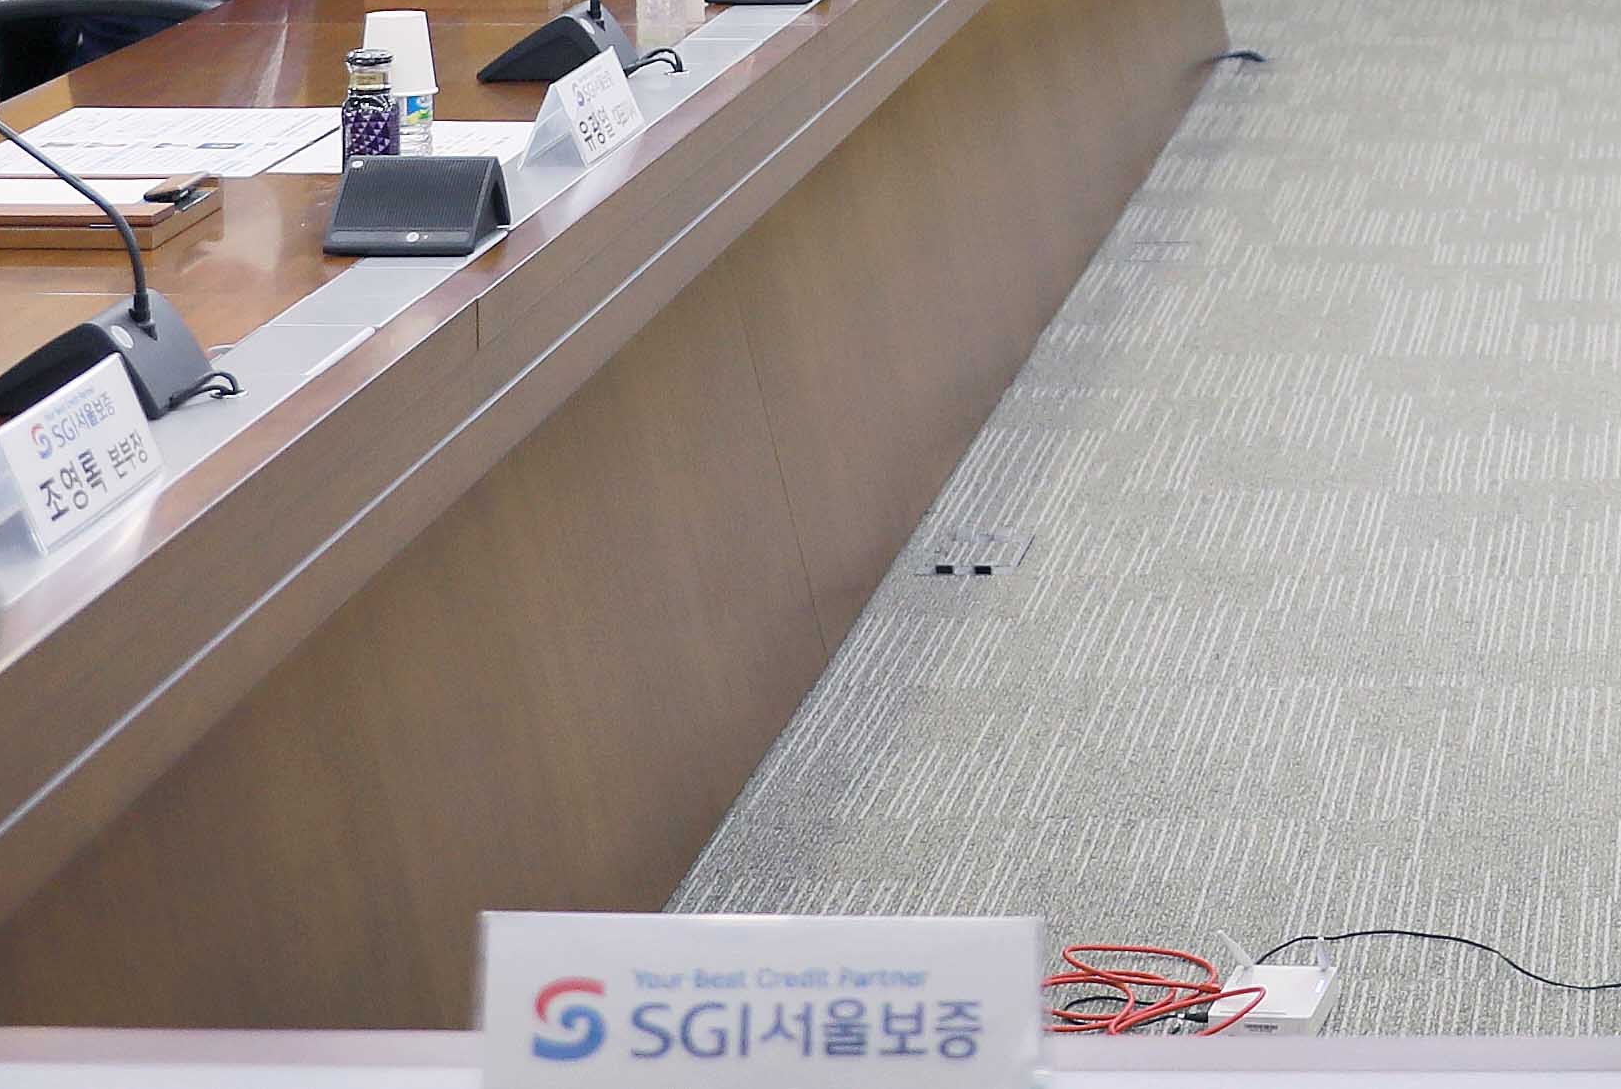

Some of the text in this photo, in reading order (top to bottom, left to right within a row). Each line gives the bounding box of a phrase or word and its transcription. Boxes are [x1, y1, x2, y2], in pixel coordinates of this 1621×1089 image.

[39, 429, 149, 522] 조영록 본부장
[633, 967, 928, 989] Your Best Credit Partner
[629, 997, 984, 1061] SGI서울보증
